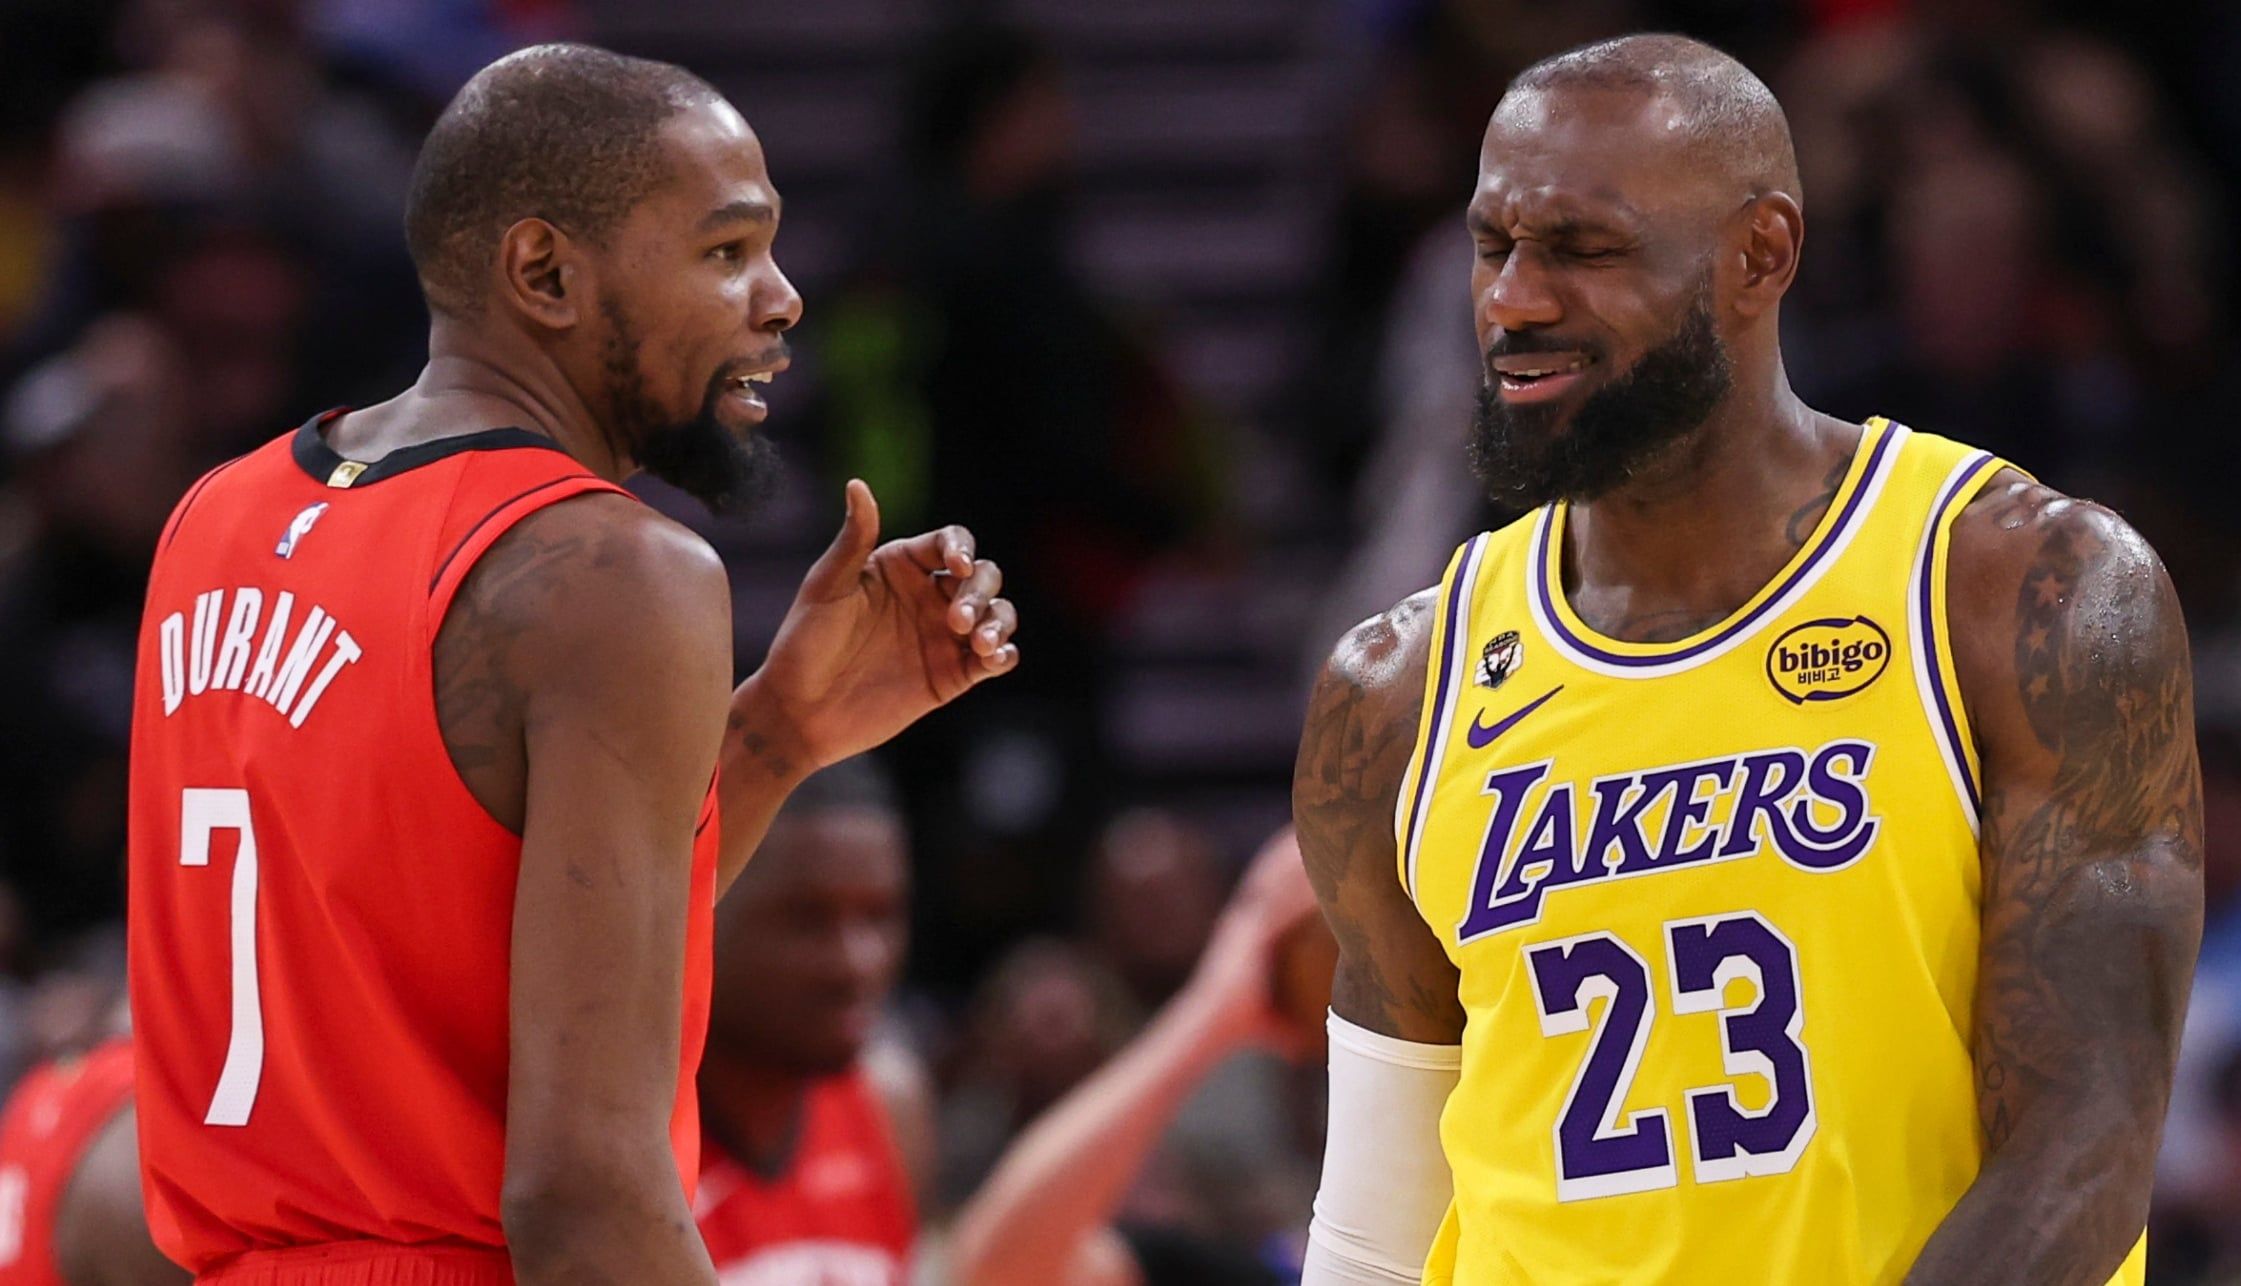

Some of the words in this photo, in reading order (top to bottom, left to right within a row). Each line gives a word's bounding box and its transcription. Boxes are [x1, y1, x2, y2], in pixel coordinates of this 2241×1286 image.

[160, 587, 363, 729] DURANT
[1779, 638, 1883, 673] bibigo
[1797, 667, 1841, 685] 비비고
[1456, 739, 1882, 946] LAKERS
[180, 788, 264, 1126] 7
[1522, 909, 1818, 1203] 23
